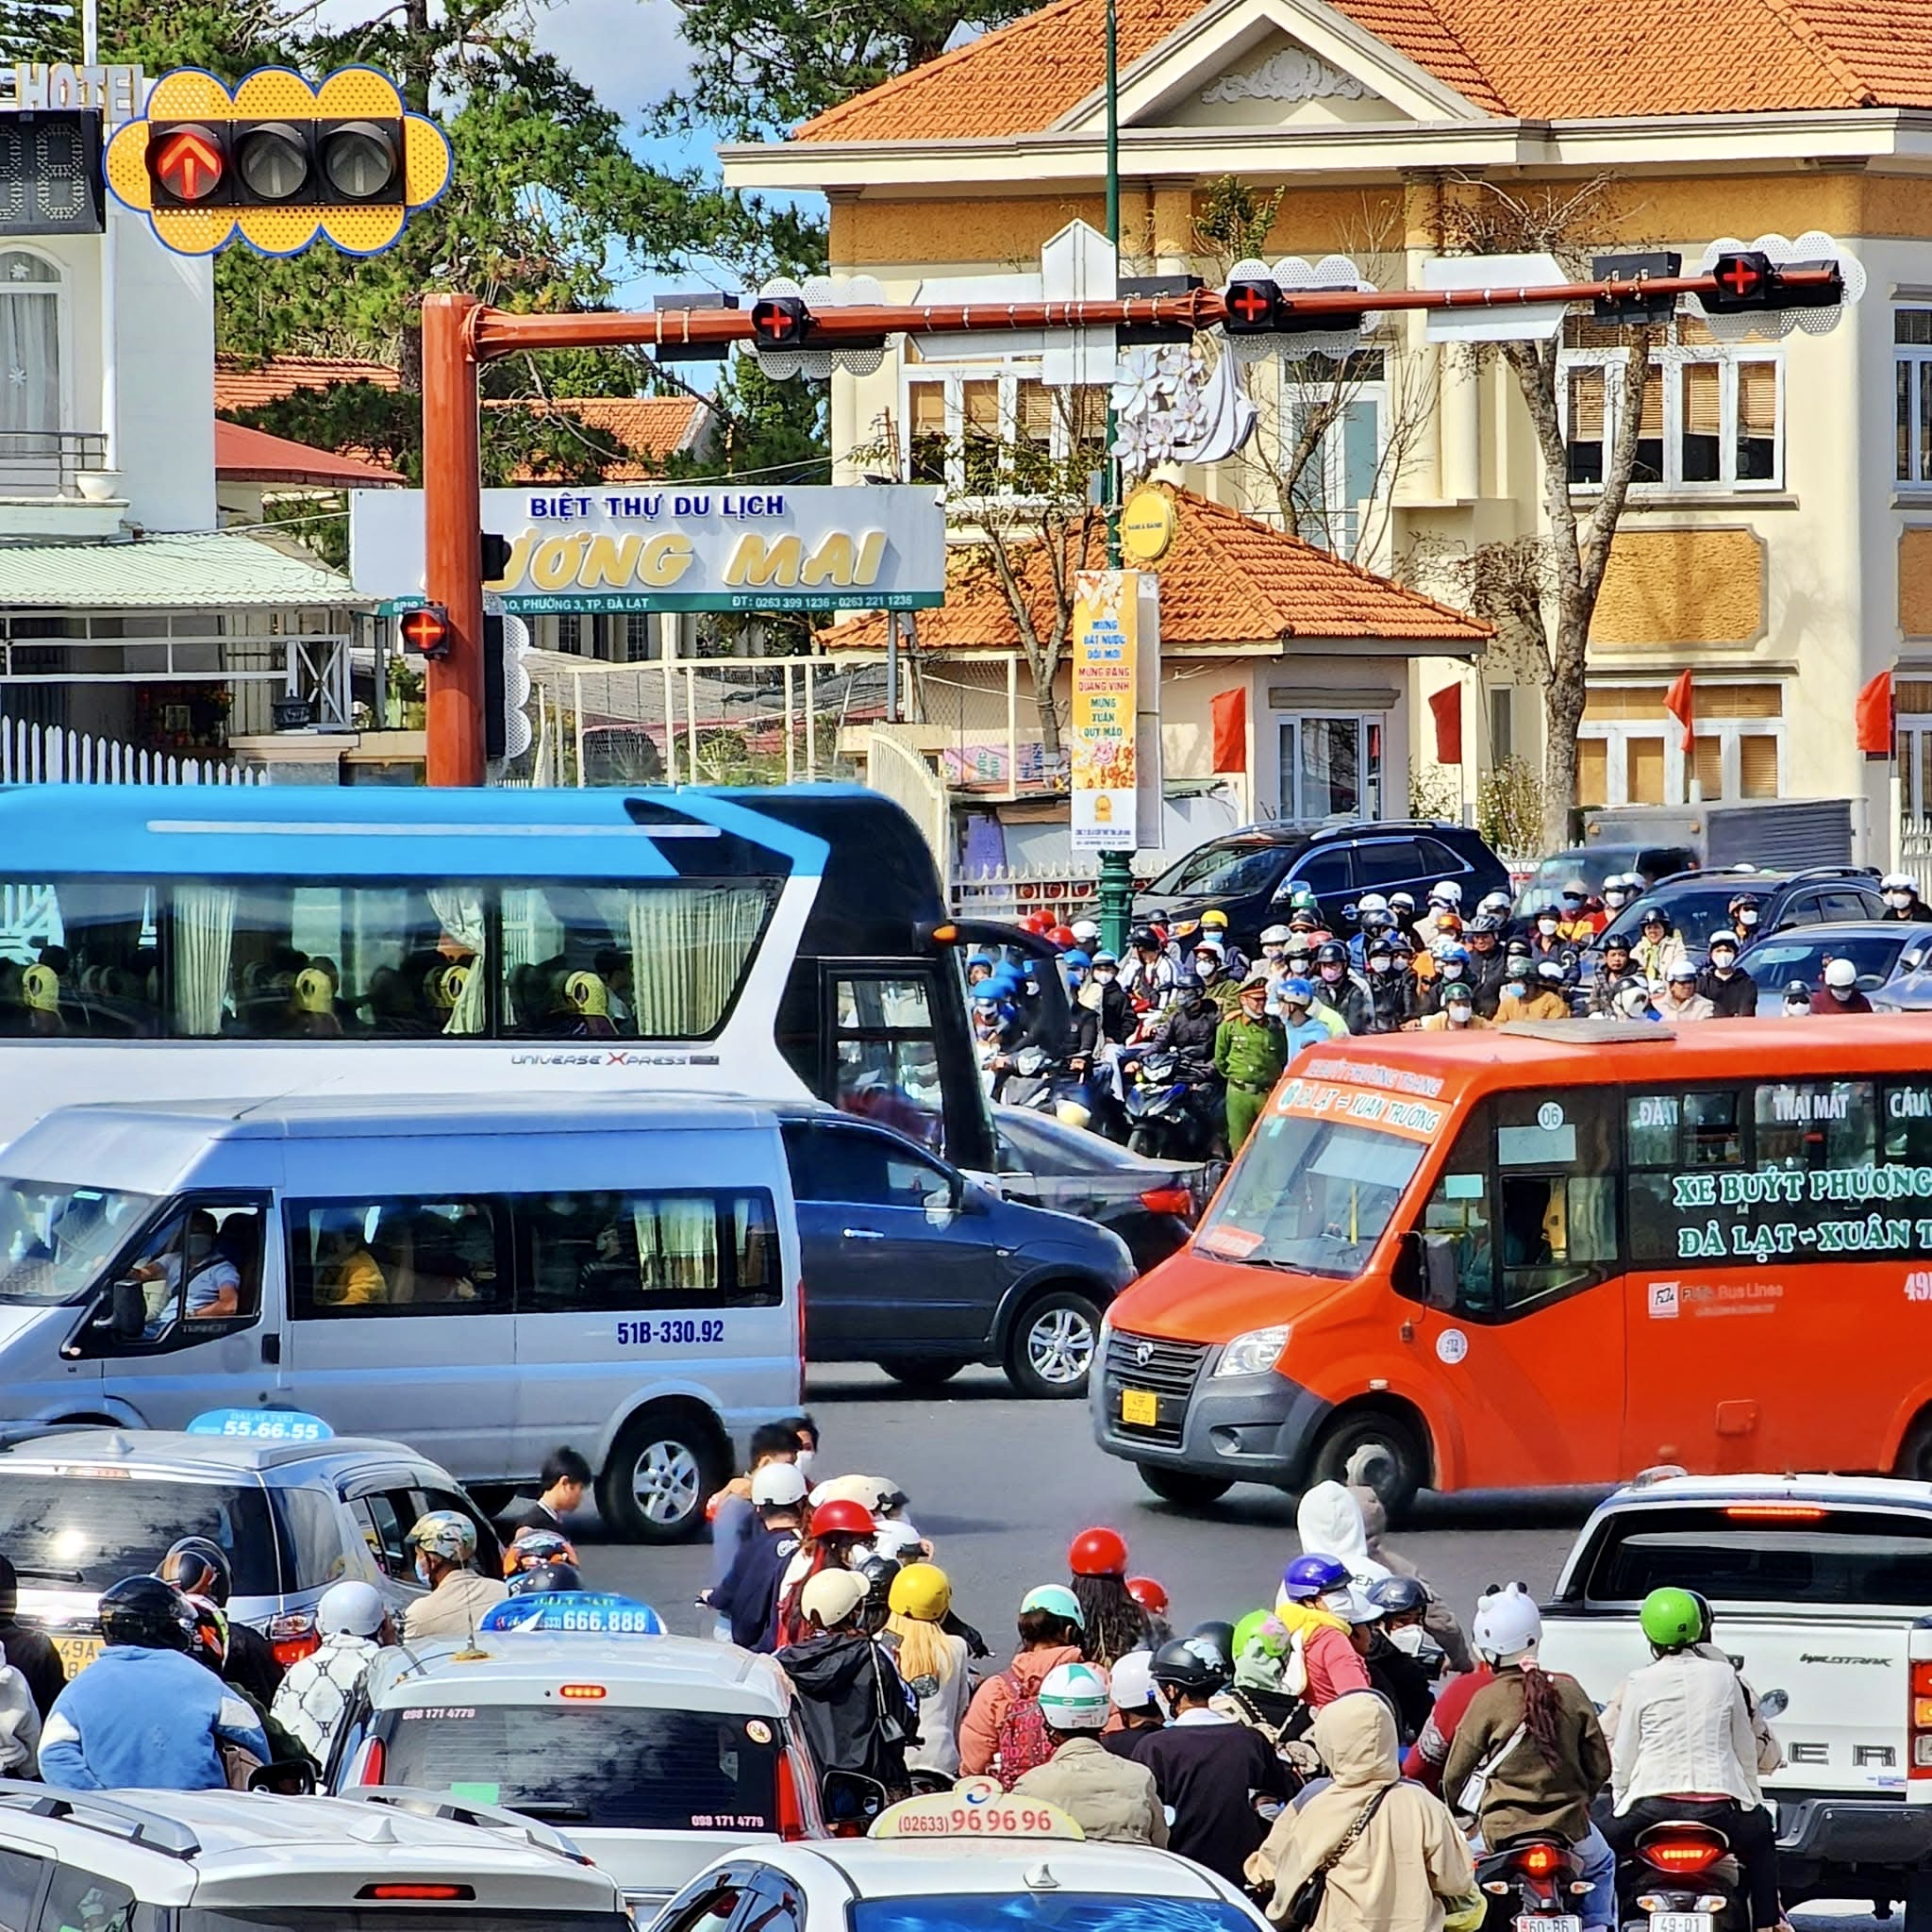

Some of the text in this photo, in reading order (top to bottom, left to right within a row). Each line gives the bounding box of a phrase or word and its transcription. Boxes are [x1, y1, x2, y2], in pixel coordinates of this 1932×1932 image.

[530, 492, 783, 521] BIỆT THỰ DU LỊCH
[483, 526, 888, 593] ƯƠNG MAI
[523, 596, 571, 610] PHƯỜNG
[573, 599, 585, 611] 3,
[586, 598, 605, 610] TP.
[607, 596, 630, 609] ĐÀ
[632, 597, 650, 611] LẠT
[732, 596, 753, 608] ĐT:
[756, 597, 781, 608] 0263
[782, 597, 802, 608] 399
[839, 596, 863, 608] 0263
[865, 596, 885, 607] 221
[510, 1054, 601, 1066] UNIVERSE
[606, 1051, 688, 1066] XPRESS
[1813, 1089, 1850, 1120] MÁT
[1541, 1108, 1559, 1125] 06
[1674, 1162, 1932, 1206] XE BUÝT PHƯƠNG
[1677, 1213, 1932, 1263] ĐÀ LẠT XUÂN T
[617, 1320, 724, 1345] 51B-330.92
[224, 1421, 319, 1440] 55.66.55
[563, 1610, 646, 1632] 666.888
[60, 1641, 95, 1658] 49A
[425, 1707, 445, 1719] 171
[446, 1707, 476, 1718] 4779
[1788, 1741, 1897, 1768] ER
[714, 1814, 735, 1827] 171
[737, 1815, 764, 1828] 4779
[898, 1808, 1052, 1833] (02633) 96 96 96
